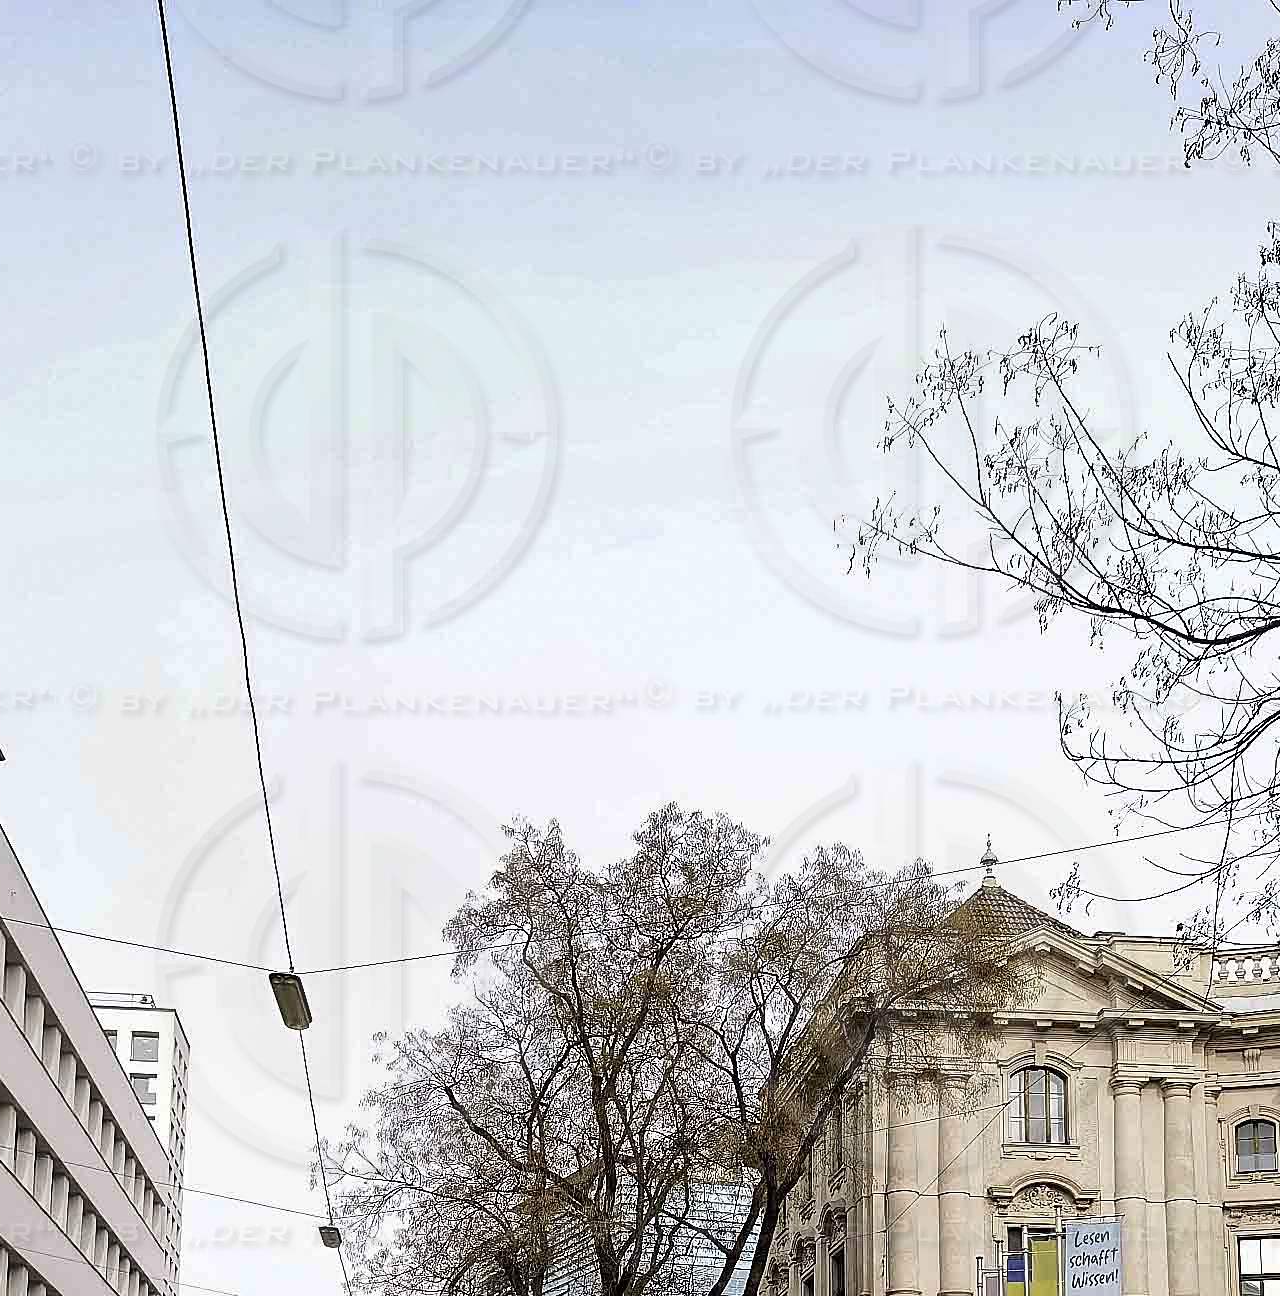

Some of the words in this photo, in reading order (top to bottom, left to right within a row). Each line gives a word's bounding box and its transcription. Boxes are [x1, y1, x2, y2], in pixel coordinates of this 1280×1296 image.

[1074, 1230, 1110, 1248] Lesen
[1070, 1248, 1118, 1269] schafft
[1072, 1269, 1119, 1289] Wissen!
